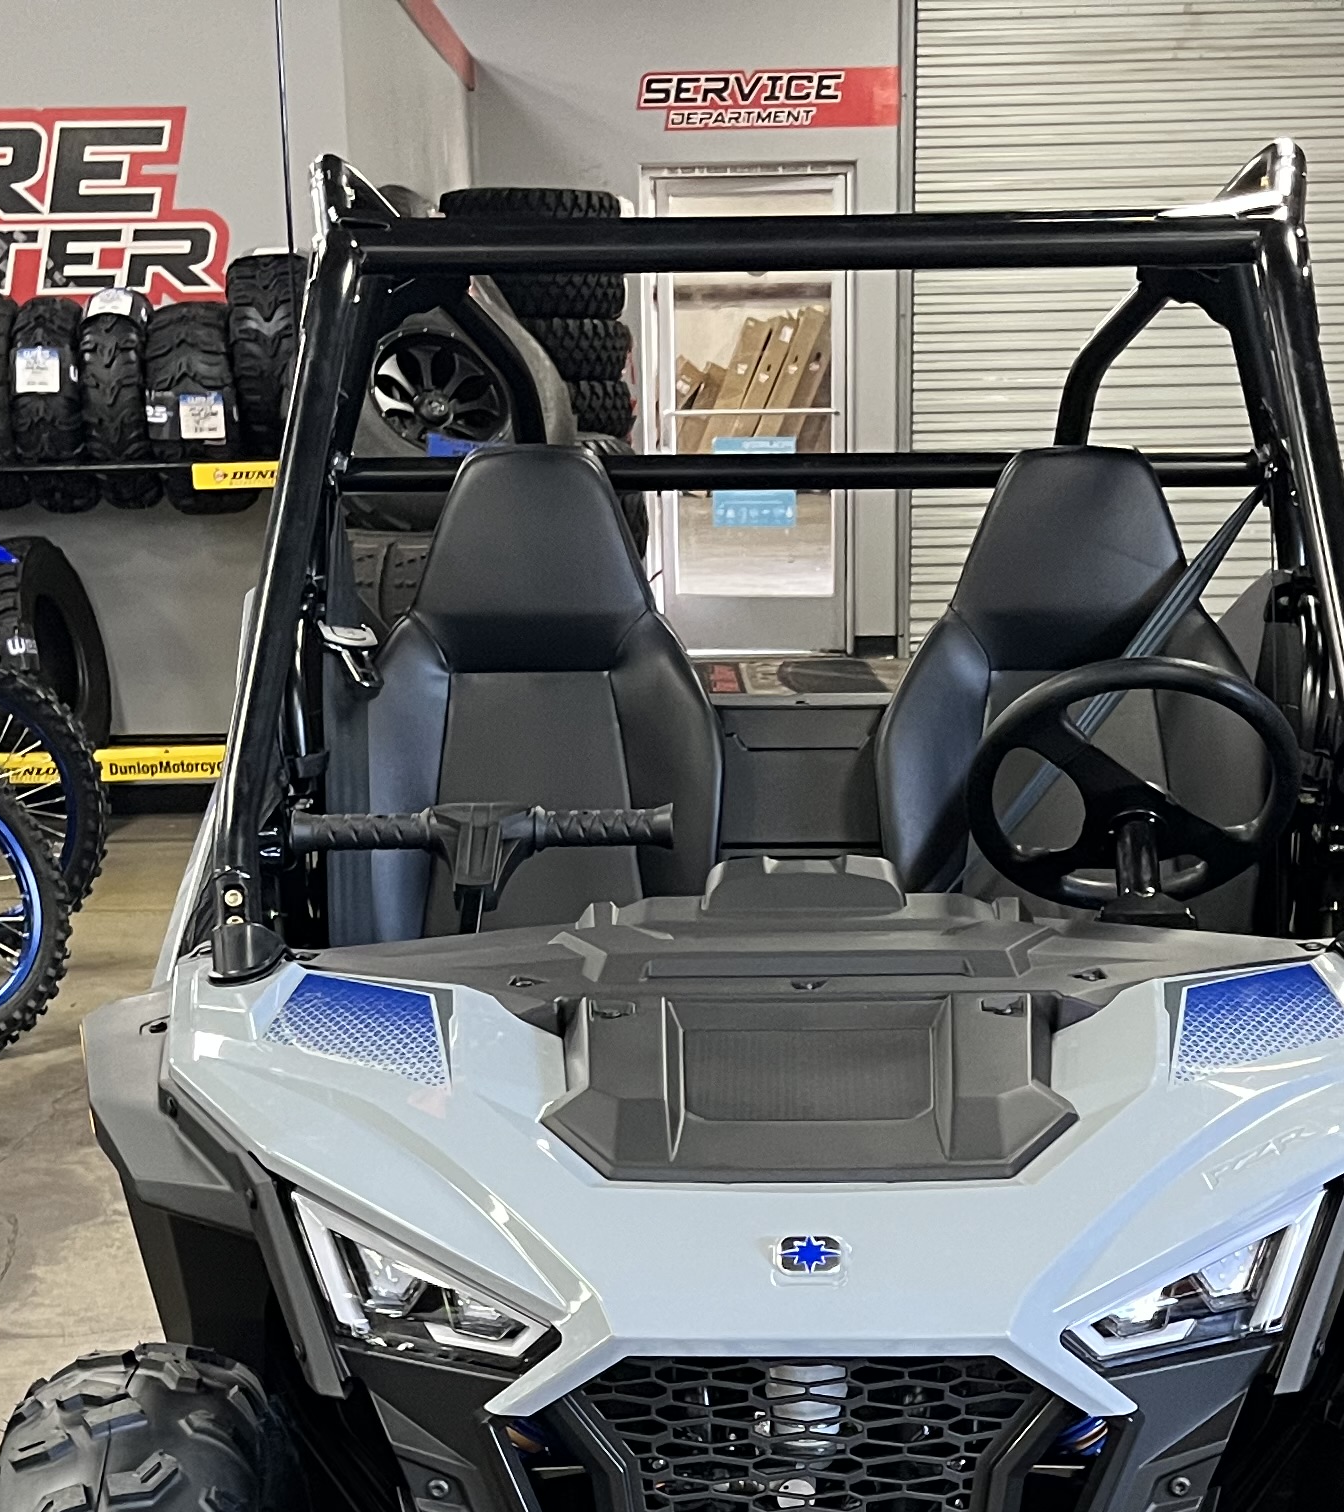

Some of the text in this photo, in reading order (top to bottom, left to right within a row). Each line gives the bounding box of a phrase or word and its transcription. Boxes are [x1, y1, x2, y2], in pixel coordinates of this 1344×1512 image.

[643, 74, 843, 104] SERVICE
[670, 109, 814, 126] DEPARTMENT
[109, 760, 224, 777] DunlopMotorcyc
